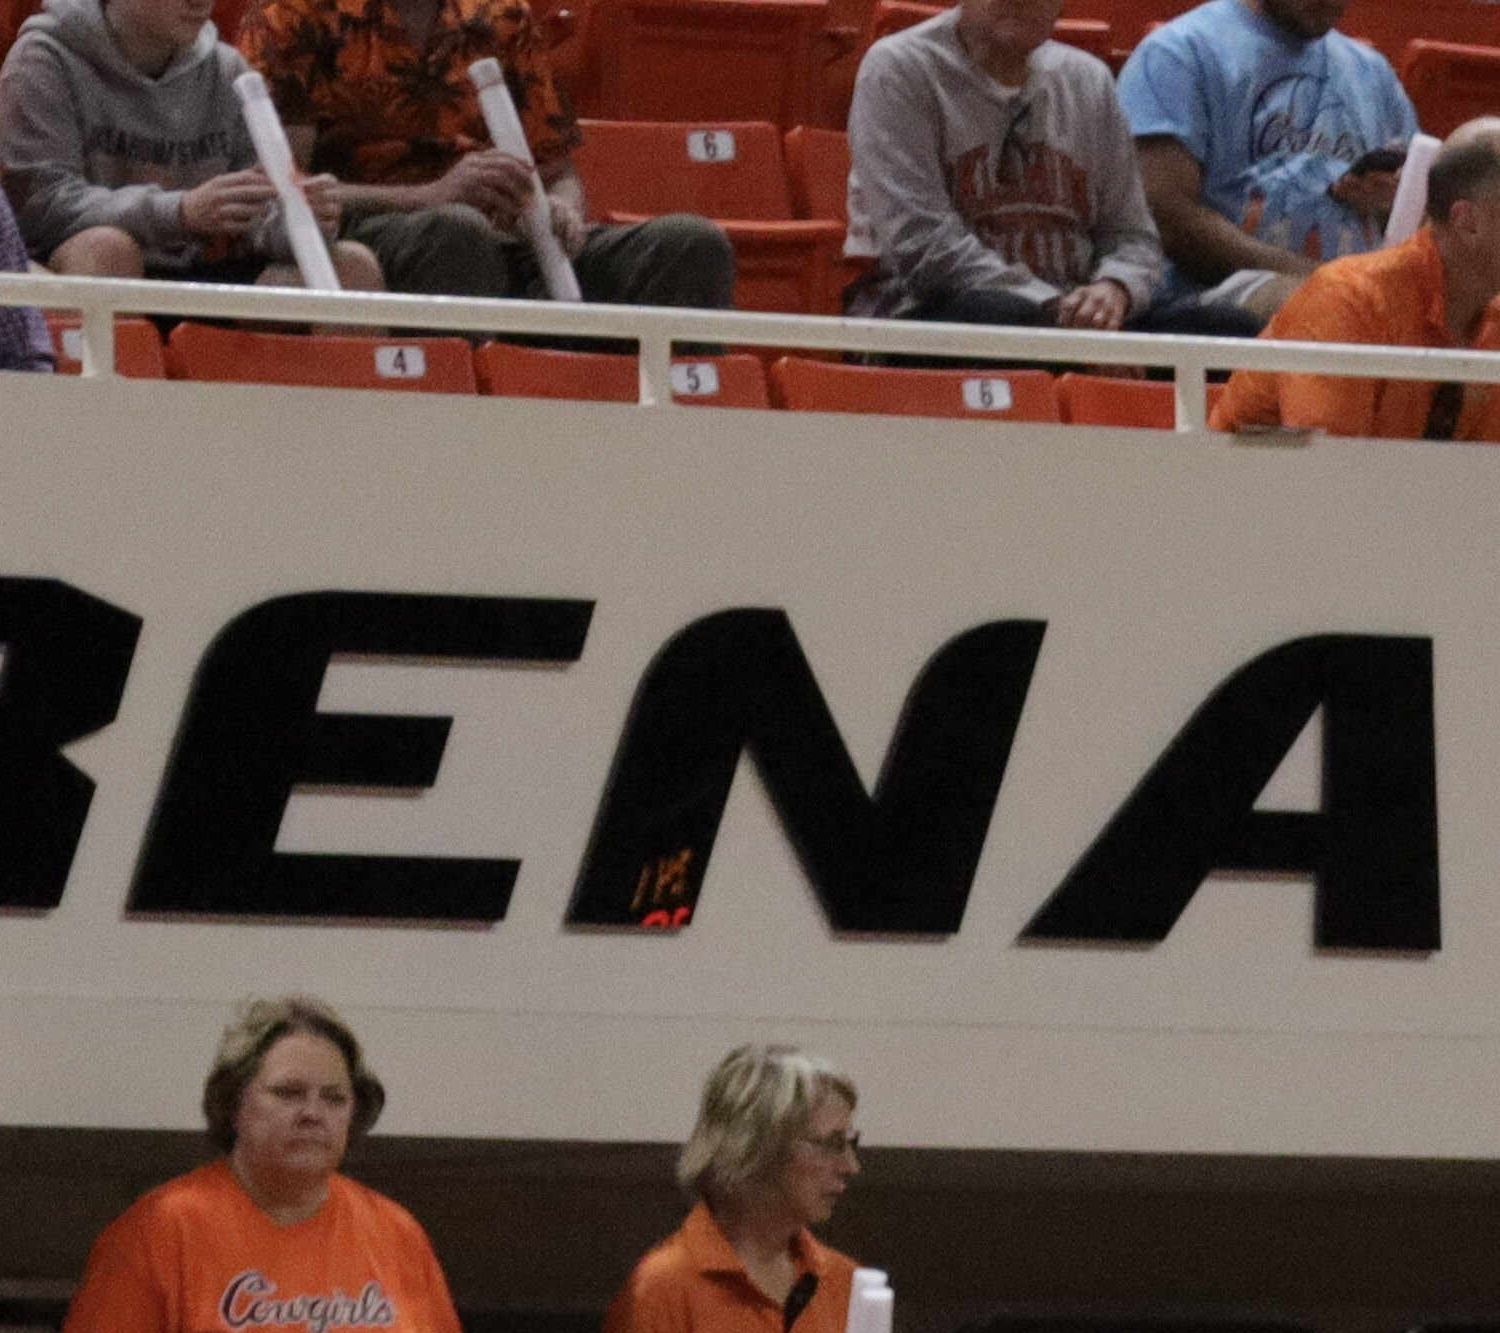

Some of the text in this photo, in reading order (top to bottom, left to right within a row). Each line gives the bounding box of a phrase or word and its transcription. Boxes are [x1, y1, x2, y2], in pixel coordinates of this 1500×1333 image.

[703, 132, 718, 159] 6
[393, 348, 407, 374] 4
[686, 364, 701, 393] 5
[978, 380, 994, 408] 6
